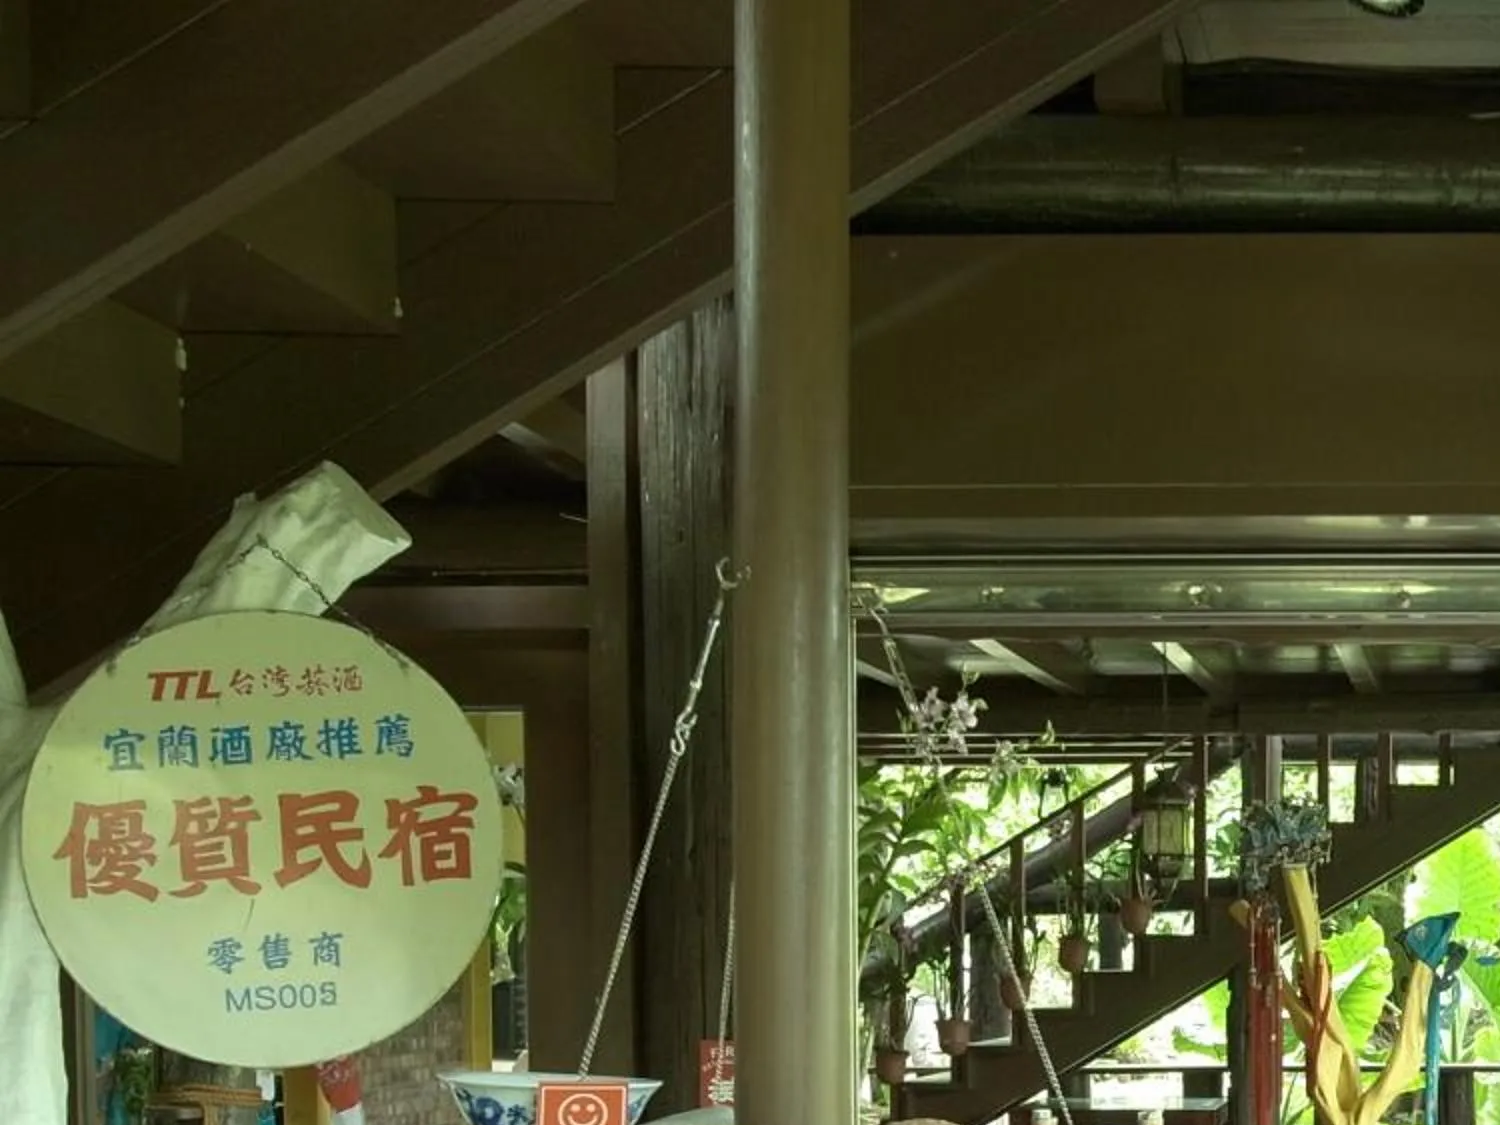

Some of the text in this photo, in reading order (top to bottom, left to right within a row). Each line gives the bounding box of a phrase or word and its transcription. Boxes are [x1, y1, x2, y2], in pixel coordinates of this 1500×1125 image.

[147, 670, 222, 701] TTL
[104, 714, 416, 771] 宜蘭酒廠推薦
[53, 785, 479, 902] 優質民宿
[207, 932, 344, 974] 零售商
